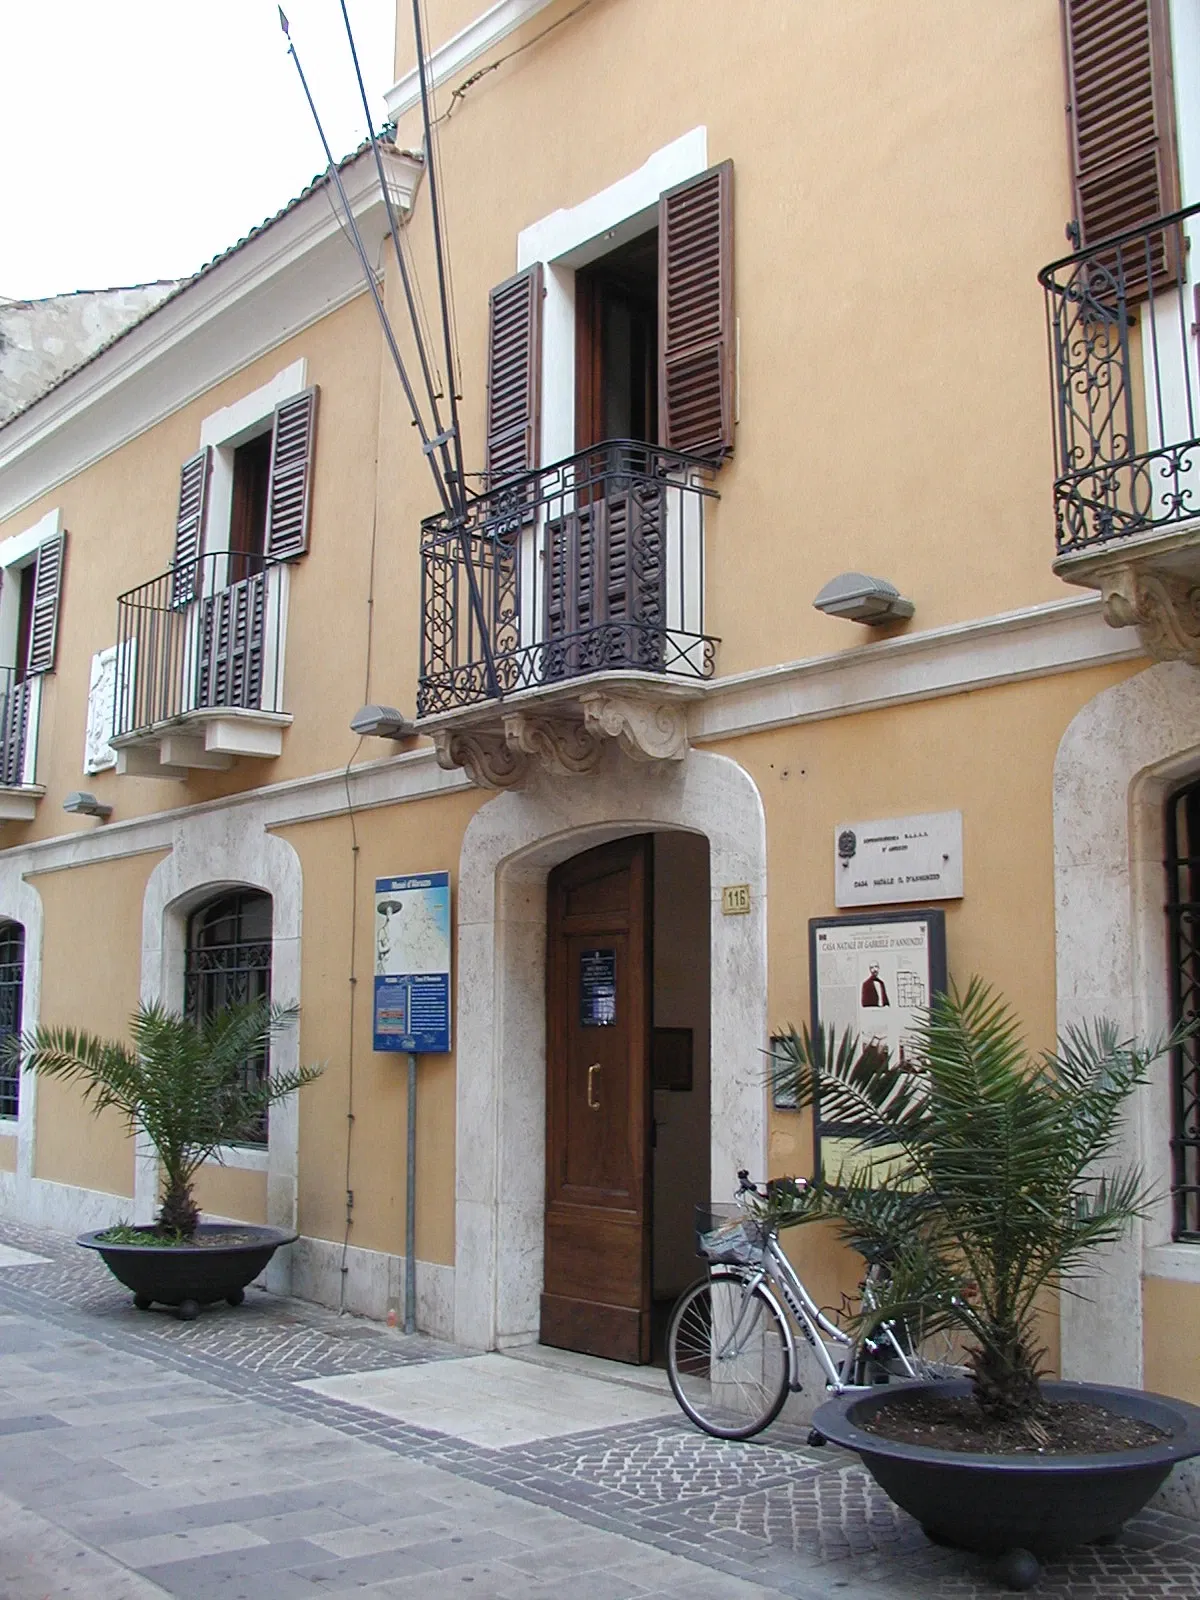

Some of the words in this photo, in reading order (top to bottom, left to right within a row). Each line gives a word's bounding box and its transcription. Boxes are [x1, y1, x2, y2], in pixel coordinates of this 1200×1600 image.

[728, 890, 745, 906] 116
[822, 943, 836, 951] CASA
[836, 941, 857, 950] NATALE
[858, 941, 863, 949] DI
[864, 939, 889, 949] GABRIELE
[890, 938, 924, 948] D'ANNUNZIO
